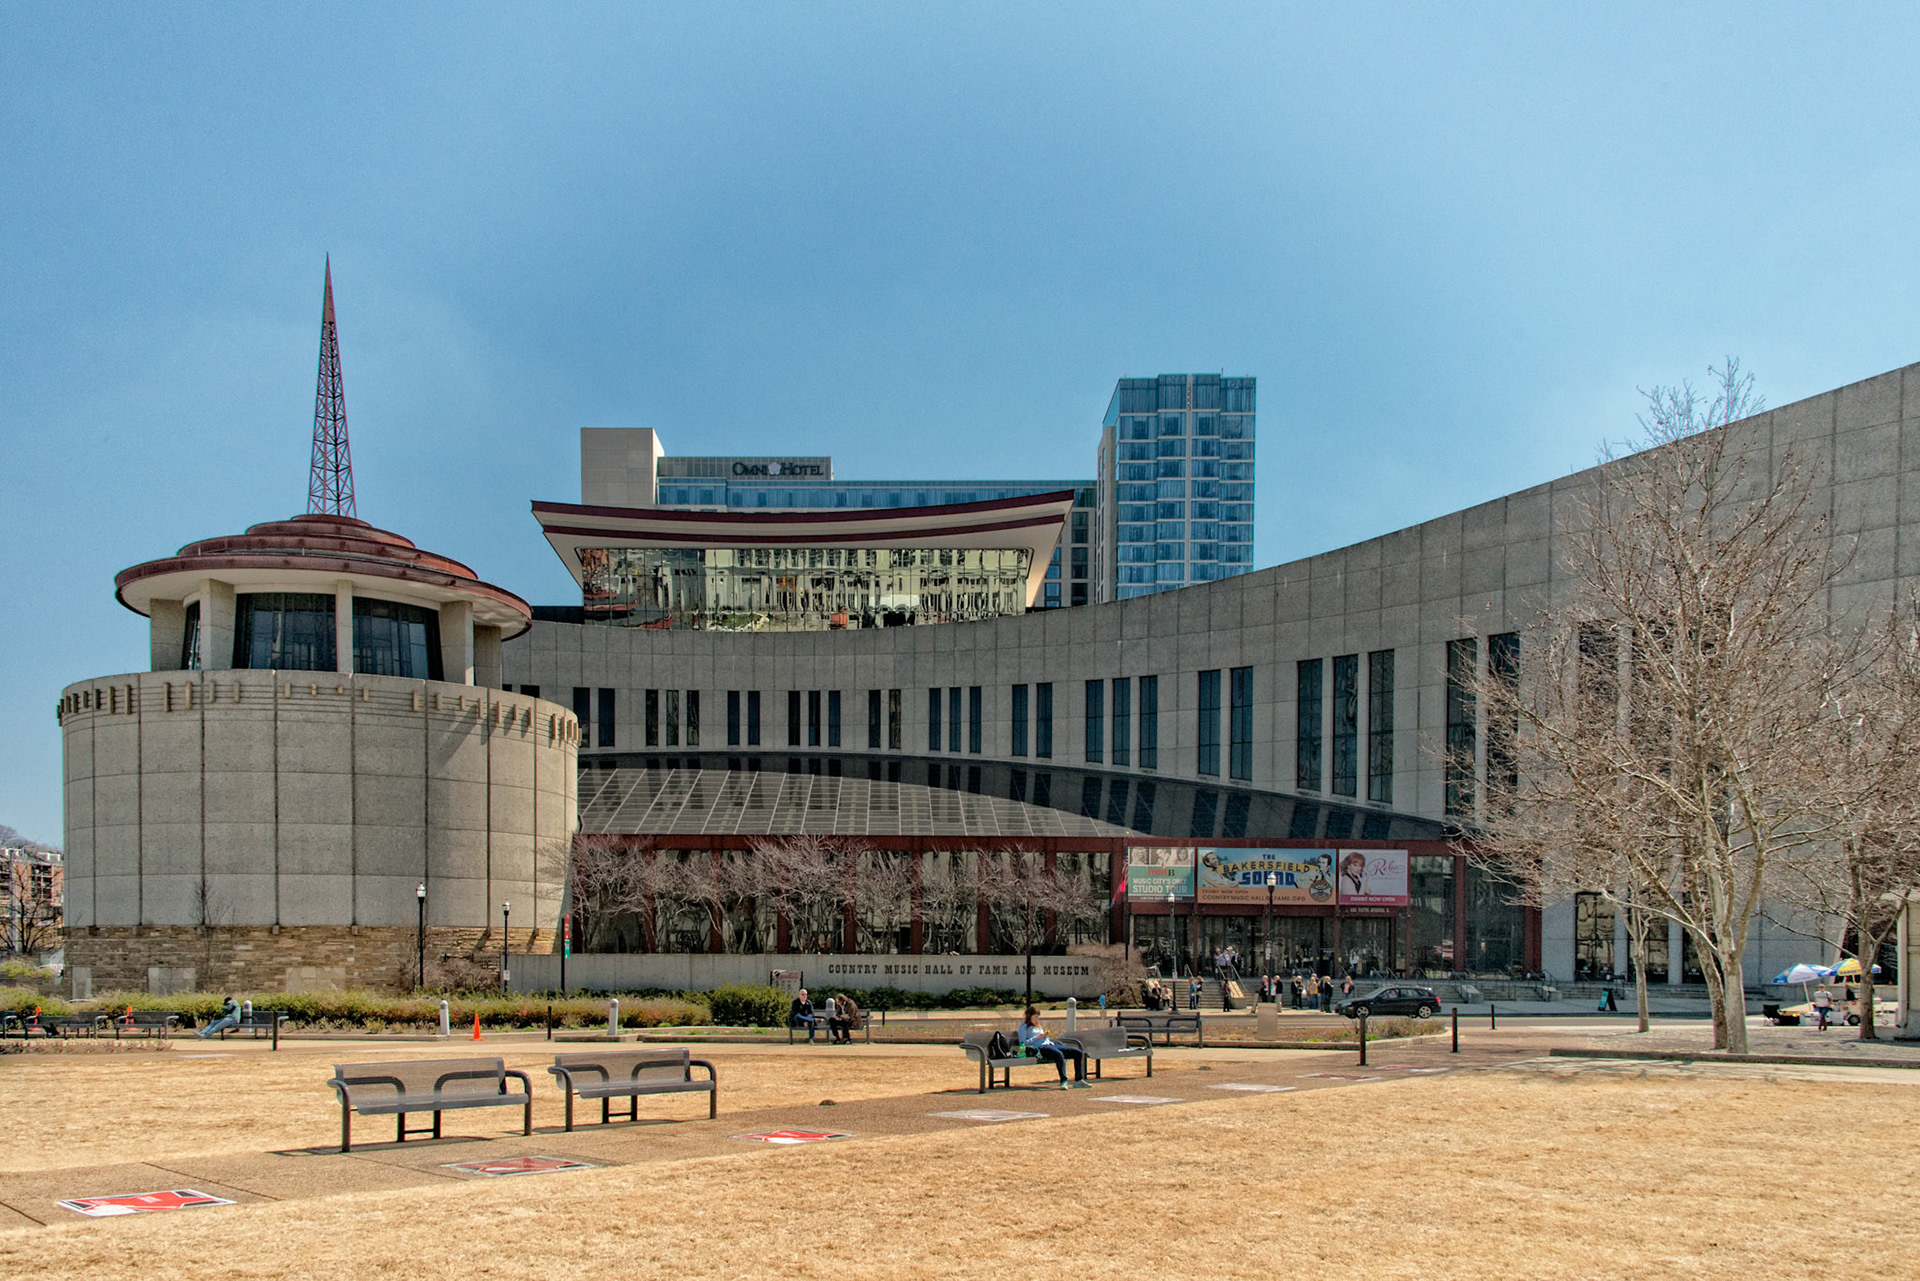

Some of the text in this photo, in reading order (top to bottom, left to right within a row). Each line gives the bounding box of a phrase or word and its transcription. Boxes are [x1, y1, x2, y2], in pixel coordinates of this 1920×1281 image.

[1223, 860, 1310, 873] BAKERSFIELD
[1132, 884, 1188, 894] STUDIO TOUR
[828, 964, 1089, 976] COUNTRY MUSIC HALL OF FAME AND MUSEUM
